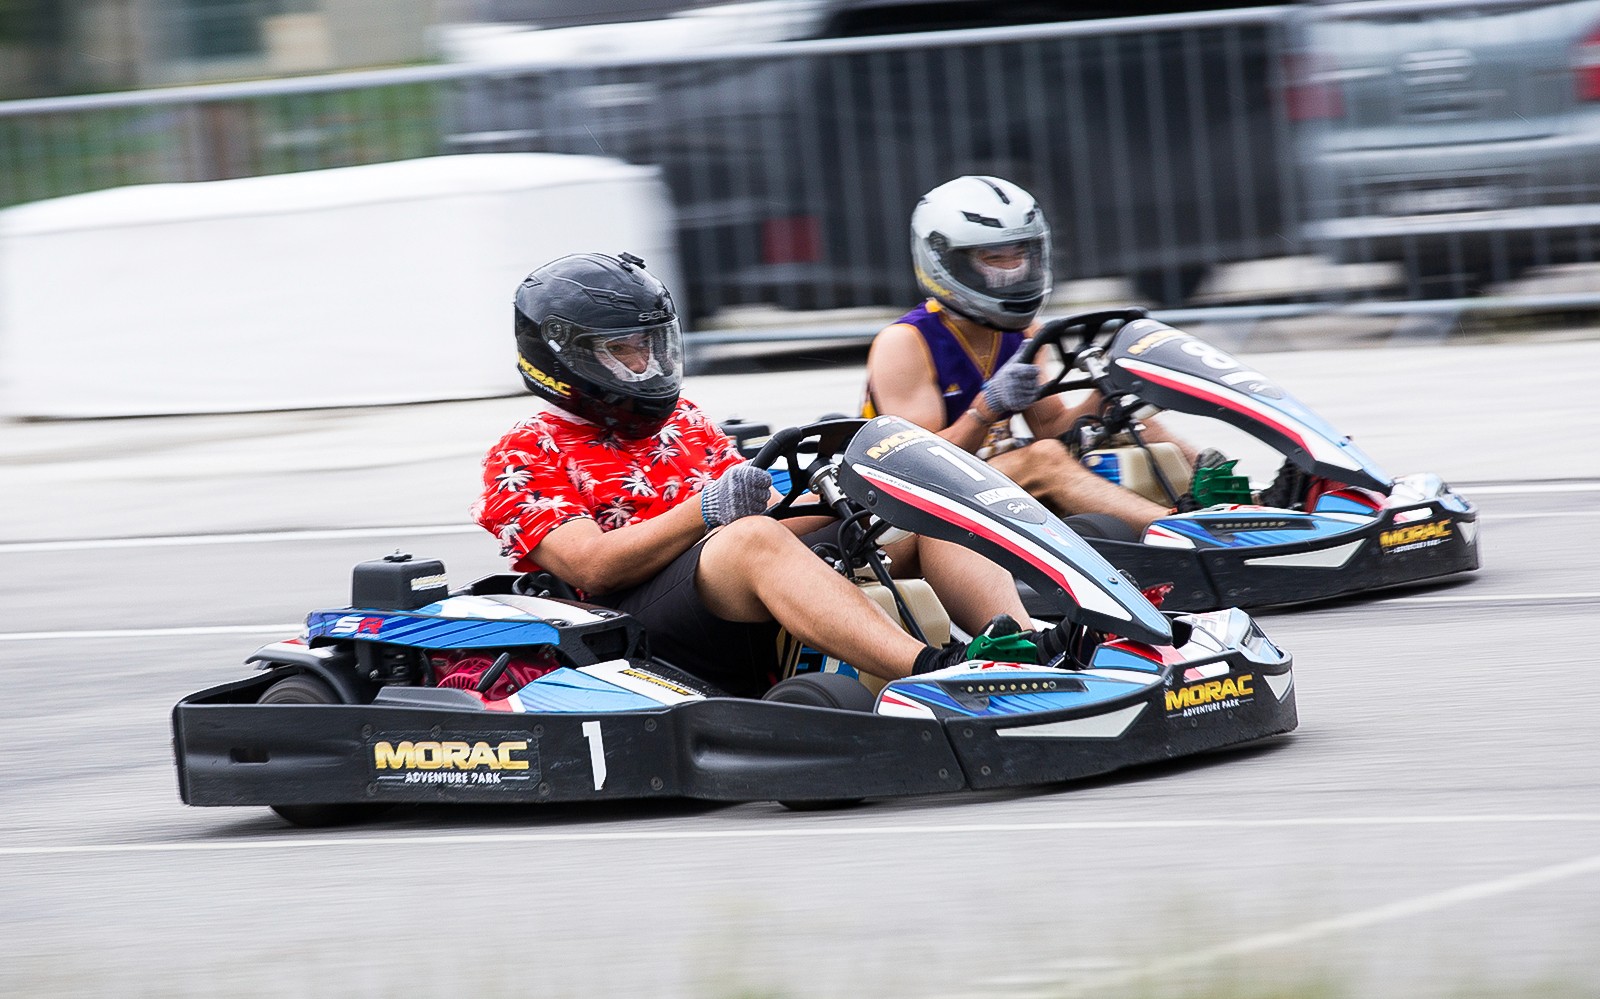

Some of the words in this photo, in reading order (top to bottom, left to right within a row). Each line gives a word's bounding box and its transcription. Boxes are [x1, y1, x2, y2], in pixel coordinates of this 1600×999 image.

[1181, 340, 1240, 370] 8
[926, 445, 986, 482] 1
[1165, 674, 1254, 711] MORAC
[1183, 701, 1221, 718] ADVENTURE
[1221, 698, 1241, 710] PARK
[374, 741, 530, 770] MORAC
[582, 720, 607, 791] 1
[404, 771, 469, 784] ADVENTURE
